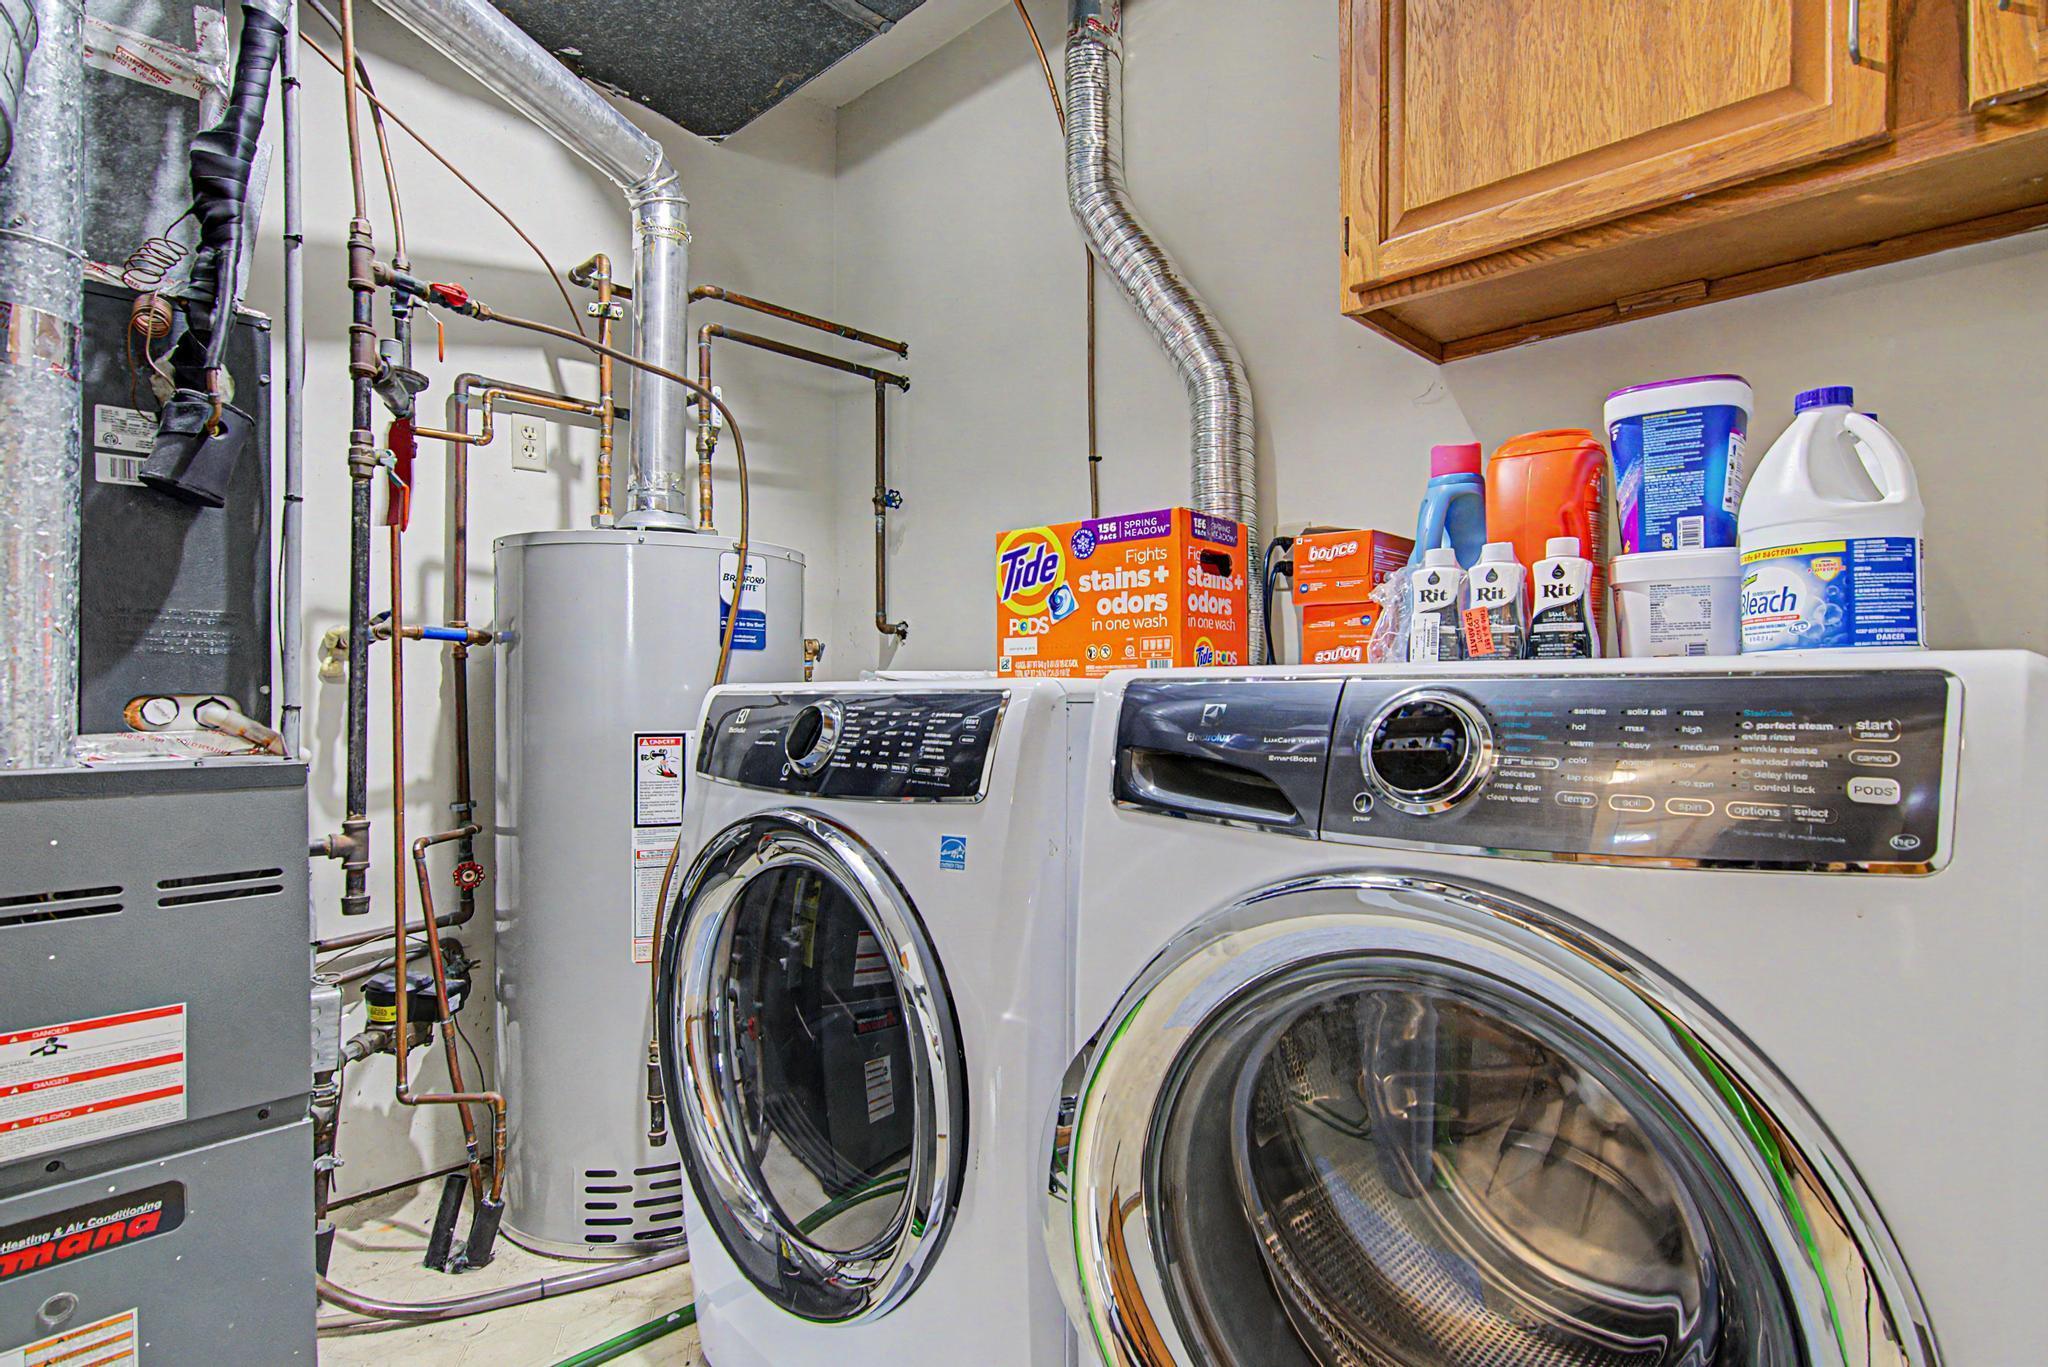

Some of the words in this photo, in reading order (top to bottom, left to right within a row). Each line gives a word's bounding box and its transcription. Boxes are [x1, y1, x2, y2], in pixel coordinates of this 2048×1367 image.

[1097, 522, 1117, 533] 156
[1124, 517, 1157, 529] SPRING
[1124, 525, 1166, 537] MEADOW
[1099, 533, 1117, 541] PACS
[1125, 546, 1168, 565] Fights
[1308, 541, 1358, 562] bounce
[1000, 542, 1059, 603] Tide
[1187, 563, 1234, 592] stains
[723, 573, 765, 584] BRFORD
[1078, 565, 1151, 592] stains
[1153, 565, 1170, 583] +
[1419, 588, 1448, 603] Rit
[1475, 586, 1507, 601] Rit
[1541, 583, 1575, 599] Rit
[1096, 592, 1168, 616] odors
[1187, 590, 1233, 616] odors
[1009, 616, 1050, 637] PODS
[1091, 618, 1103, 631] in
[1106, 618, 1130, 631] one
[1133, 614, 1168, 629] wash
[1187, 613, 1196, 628] in
[1197, 617, 1214, 629] one
[1215, 618, 1236, 631] wash
[1195, 645, 1213, 667] Tide
[1215, 650, 1238, 665] PODS
[1315, 646, 1361, 663] bounce
[1627, 708, 1648, 716] solid
[1650, 708, 1667, 716] soil
[1571, 723, 1586, 731] hot
[1681, 725, 1703, 735] high
[1756, 721, 1796, 731] perfect
[1798, 722, 1834, 731] steam
[1855, 719, 1894, 731] start
[1263, 736, 1296, 744] LuxCare
[1741, 733, 1767, 741] extra
[1769, 733, 1796, 742] rinse
[1622, 741, 1651, 750] heavy
[1741, 745, 1777, 754] wrinkle
[1779, 746, 1819, 755] release
[1268, 755, 1317, 763] SmartBoost
[1740, 757, 1788, 767] extended
[1790, 759, 1828, 768] refresh
[1856, 753, 1893, 763] cancel
[1754, 771, 1782, 781] delay
[1784, 771, 1808, 781] time
[1693, 780, 1714, 789] spin
[1753, 783, 1790, 793] control
[1793, 784, 1816, 794] lock
[1854, 785, 1893, 796] PODS
[1564, 794, 1591, 804] temp
[1622, 798, 1641, 807] soil
[1678, 802, 1702, 812] spin
[1734, 806, 1781, 817] options
[1794, 807, 1829, 817] select
[0, 1232, 50, 1254] Heating
[53, 1226, 63, 1241] &
[65, 1220, 85, 1236] Air
[87, 1200, 163, 1228] Conditioning
